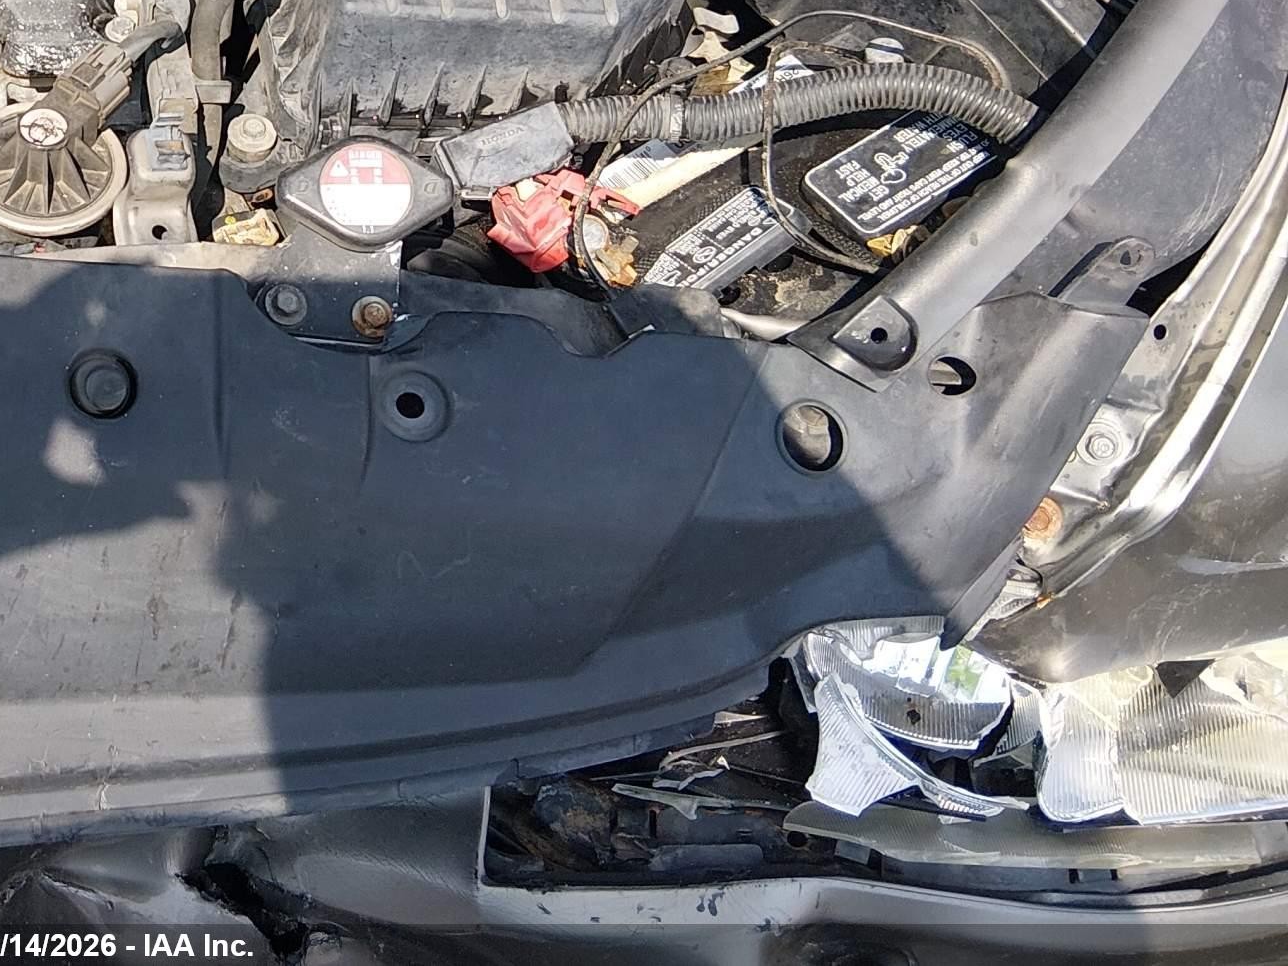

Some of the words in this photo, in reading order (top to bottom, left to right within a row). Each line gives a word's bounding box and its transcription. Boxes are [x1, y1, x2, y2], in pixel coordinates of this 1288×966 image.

[480, 126, 524, 146] HONDA
[891, 120, 928, 143] WATER
[939, 122, 969, 142] EYES
[944, 130, 979, 153] FLUSH
[834, 159, 861, 178] FAST
[842, 167, 871, 187] HELP
[837, 175, 880, 203] MEDICAL
[866, 184, 891, 201] GET
